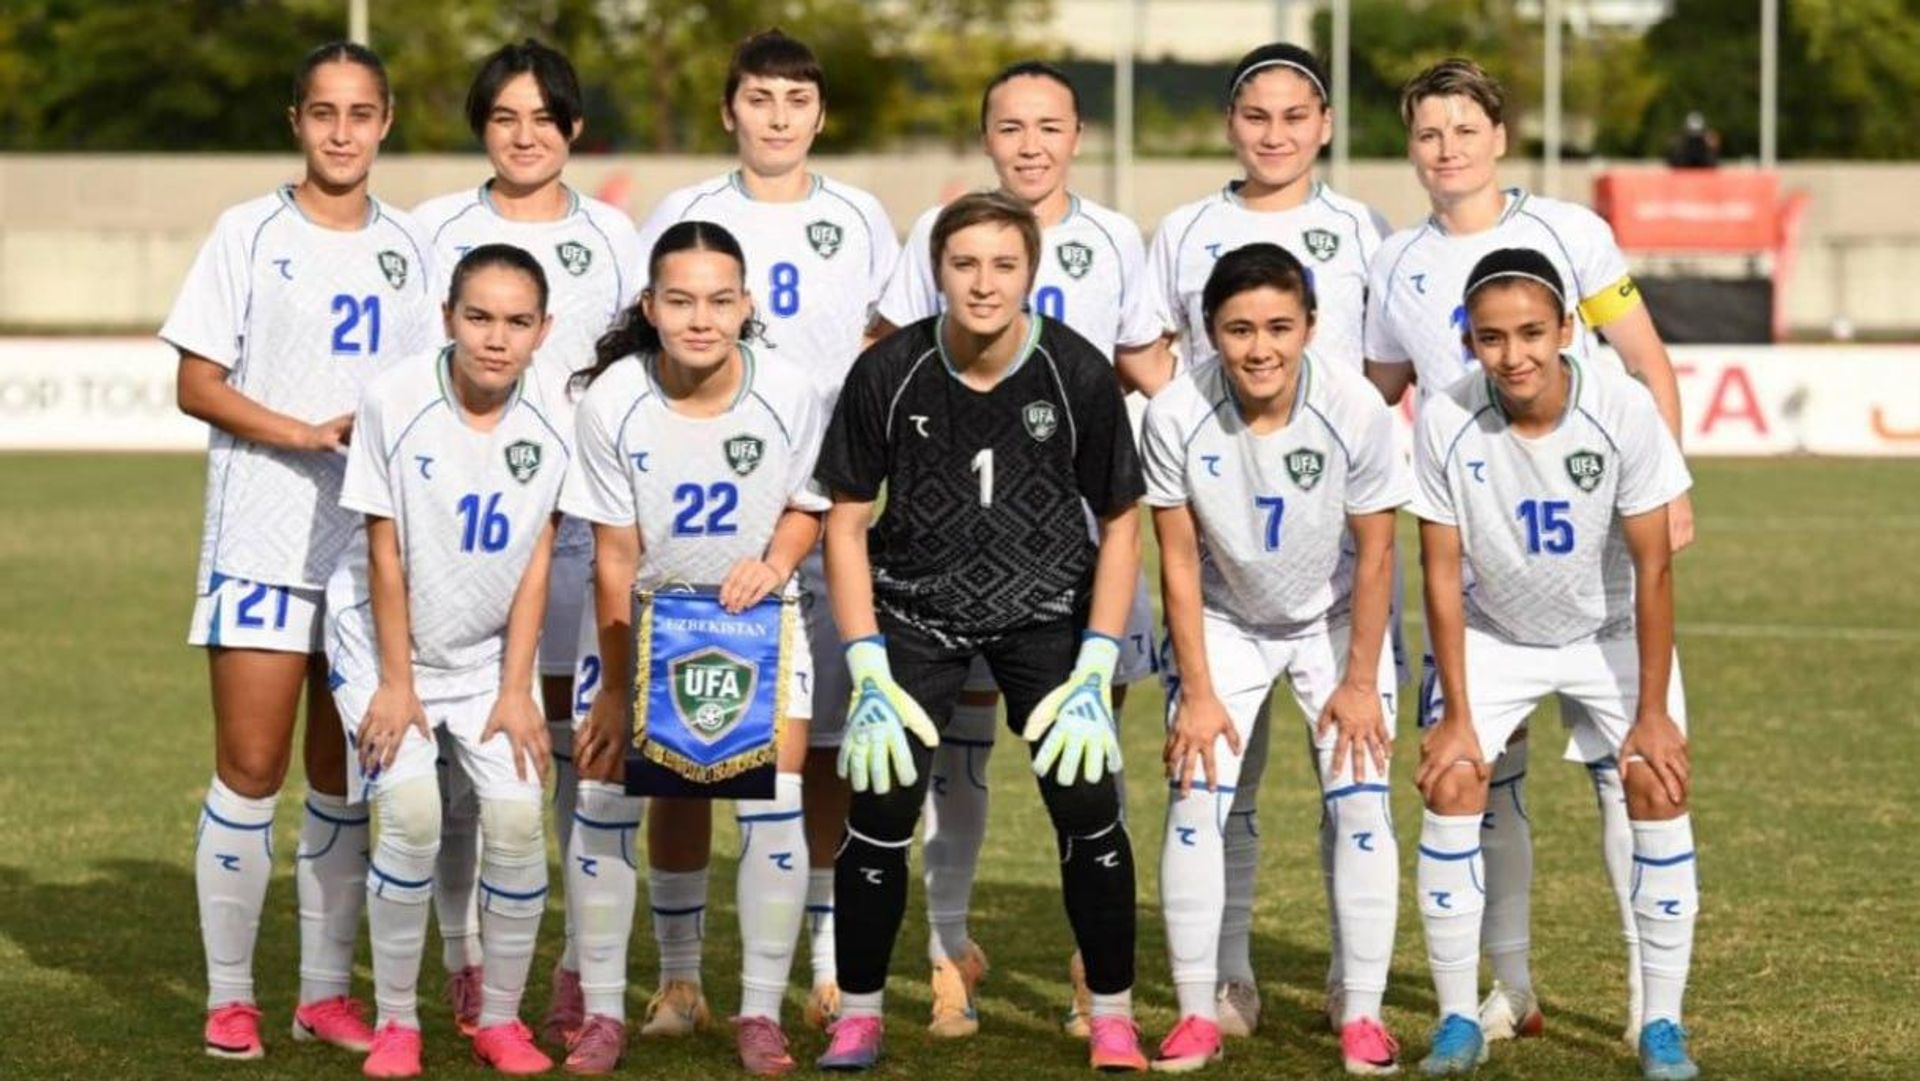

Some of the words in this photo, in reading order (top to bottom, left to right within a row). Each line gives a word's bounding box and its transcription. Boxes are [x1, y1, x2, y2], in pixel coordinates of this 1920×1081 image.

[811, 226, 839, 244] UFA
[1309, 233, 1336, 250] UFA
[1061, 246, 1088, 266] UFA
[770, 262, 801, 319] 8
[331, 294, 382, 355] 21
[1029, 407, 1056, 424] UFA
[510, 446, 538, 468] UFA
[731, 441, 758, 460] UFA
[1290, 454, 1320, 473] UFA
[972, 448, 993, 507] 1
[1571, 456, 1600, 476] UFA
[457, 492, 511, 553] 16
[672, 481, 739, 537] 22
[1256, 496, 1286, 551] 7
[1516, 499, 1576, 555] 15
[236, 580, 290, 630] 21
[684, 668, 741, 698] UFA
